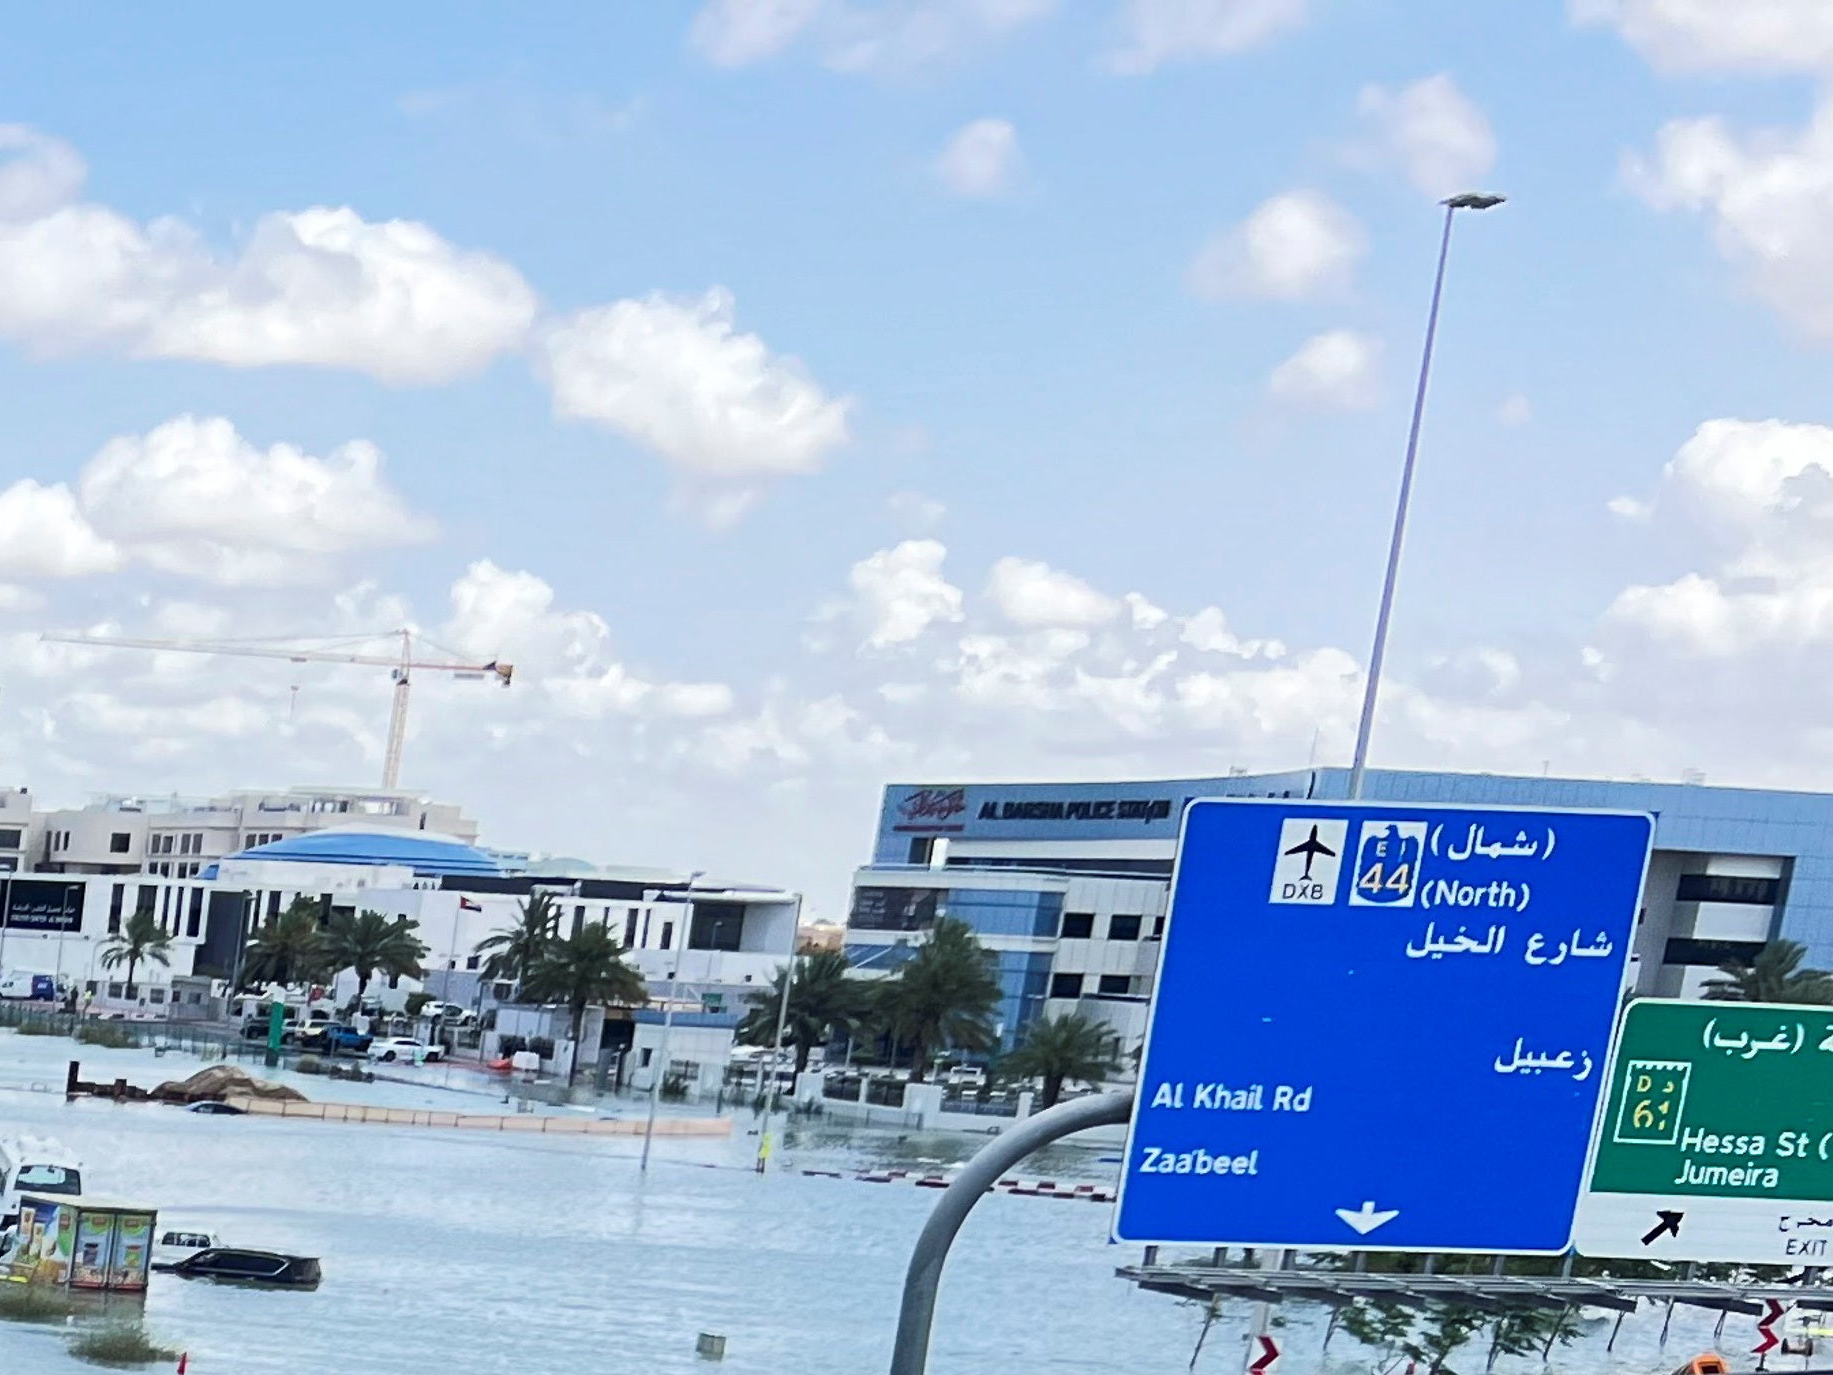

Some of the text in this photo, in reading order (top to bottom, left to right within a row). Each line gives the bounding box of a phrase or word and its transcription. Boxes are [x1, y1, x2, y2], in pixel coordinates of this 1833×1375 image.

[1431, 824, 1556, 861] (شمال)
[1282, 884, 1324, 901] DXB
[1358, 862, 1410, 895] 44
[1420, 879, 1531, 912] (North)
[1405, 922, 1613, 964] شارع الخيل
[1702, 1017, 1805, 1060] (غرب)
[1494, 1036, 1593, 1081] زعبيل
[1150, 1082, 1313, 1112] Al Khail Rd
[1636, 1075, 1653, 1093] D
[1679, 1126, 1766, 1156] Hessa
[1775, 1130, 1810, 1157] St
[1674, 1158, 1780, 1188] Jumeira
[1785, 1238, 1828, 1256] EXIT
